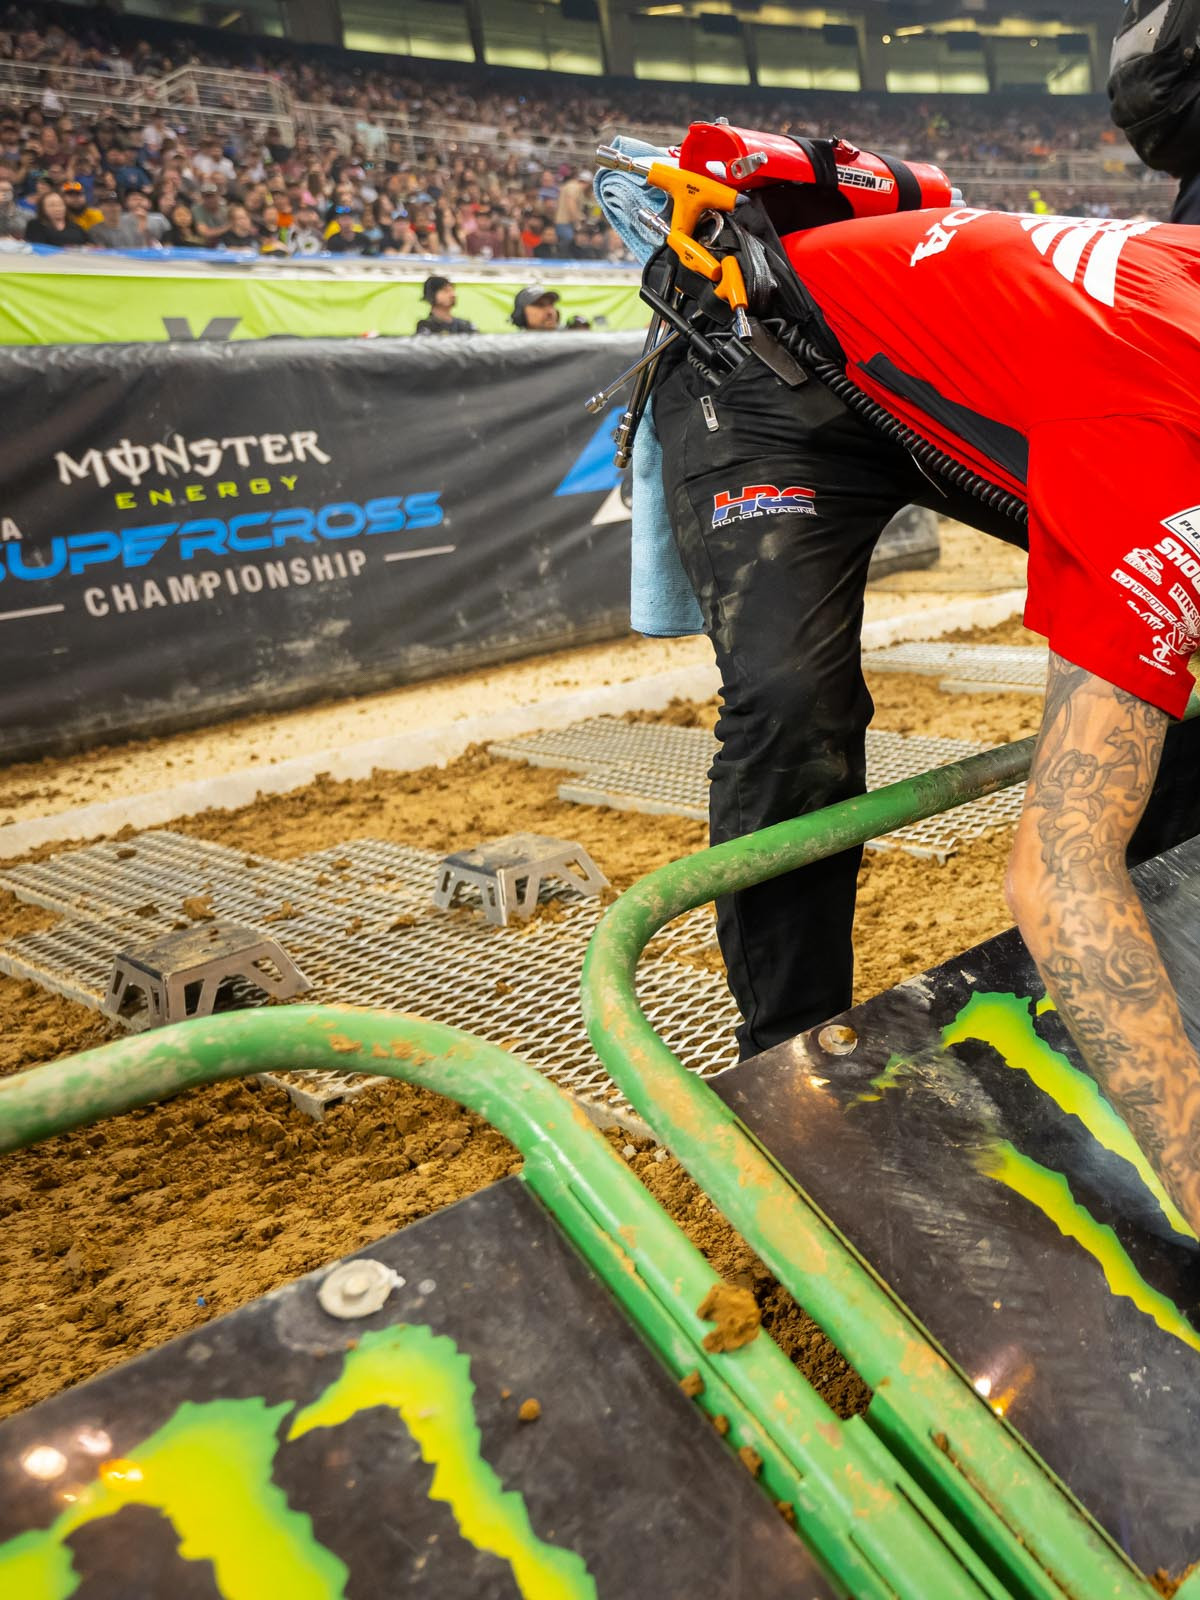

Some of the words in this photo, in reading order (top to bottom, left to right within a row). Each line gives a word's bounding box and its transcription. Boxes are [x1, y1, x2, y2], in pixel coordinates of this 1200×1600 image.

[836, 171, 876, 189] WISEC
[54, 430, 331, 488] MONSTER
[115, 474, 300, 509] ENERGY
[712, 484, 816, 523] HRC
[0, 491, 444, 582] UPERCROSS
[712, 511, 763, 529] Honda
[766, 507, 817, 516] RACING
[1179, 520, 1200, 539] Pro
[84, 550, 367, 617] CHAMPIONSHIP
